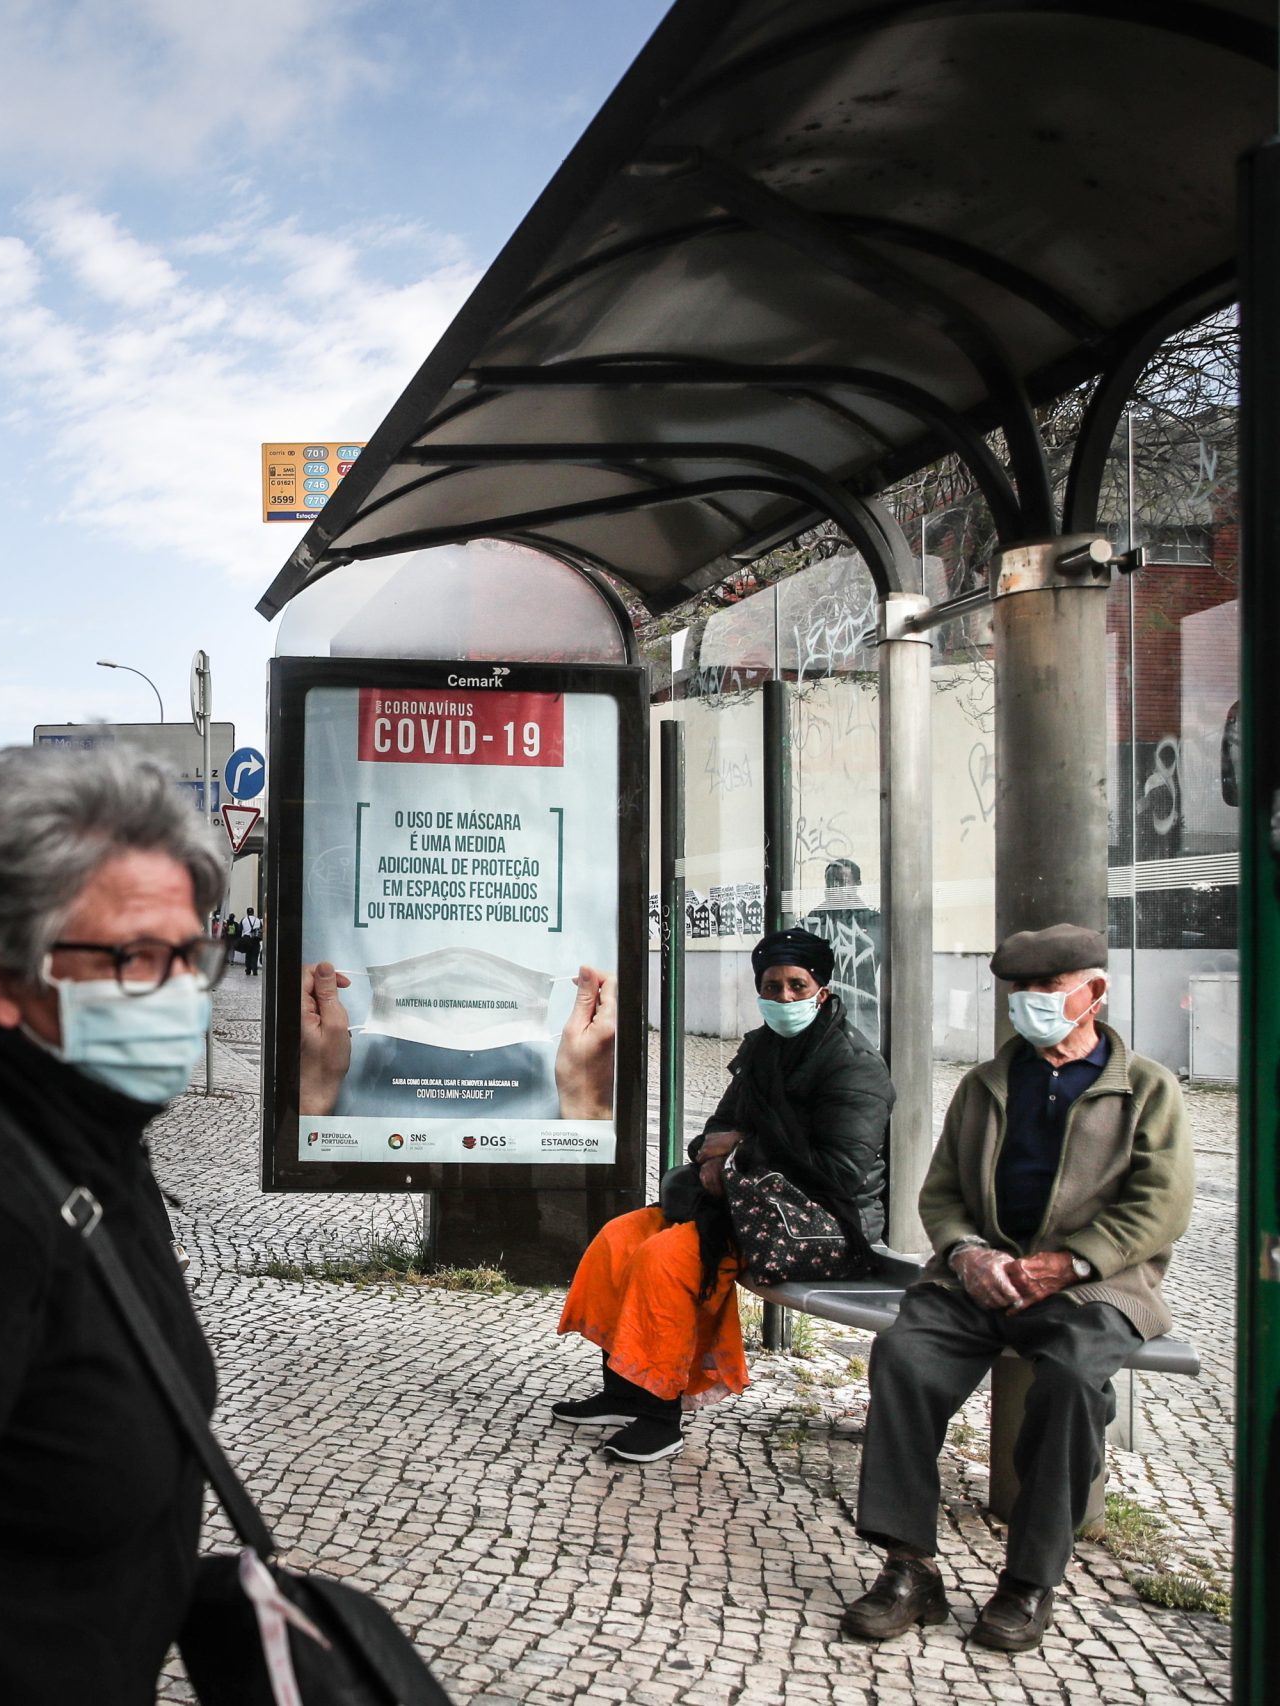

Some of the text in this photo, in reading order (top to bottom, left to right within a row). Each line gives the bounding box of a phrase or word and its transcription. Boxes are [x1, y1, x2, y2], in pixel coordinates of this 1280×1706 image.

[340, 449, 359, 457] 716
[308, 465, 326, 473] 726
[308, 481, 326, 489] 746
[271, 496, 294, 504] 3599
[308, 496, 326, 505] 770
[448, 674, 503, 688] Cemark
[384, 700, 474, 716] CORONAVÍRUS
[196, 768, 218, 778] Lz
[395, 810, 521, 830] O USO DE MÁSCARA
[410, 831, 506, 853] É UMA MEDIDA
[378, 856, 540, 880] ADICIONAL DE PROTEÇÃO
[383, 879, 538, 900] EM ESPAÇOS FECHADOS
[368, 902, 549, 923] OU TRANSPORTES PÚBLICOS
[396, 998, 518, 1009] MANTENHA O DISTANCIAMENTO SOCIAL
[410, 1134, 427, 1142] SNS
[480, 1136, 507, 1147] DGS
[541, 1138, 584, 1146] ESTAMOS
